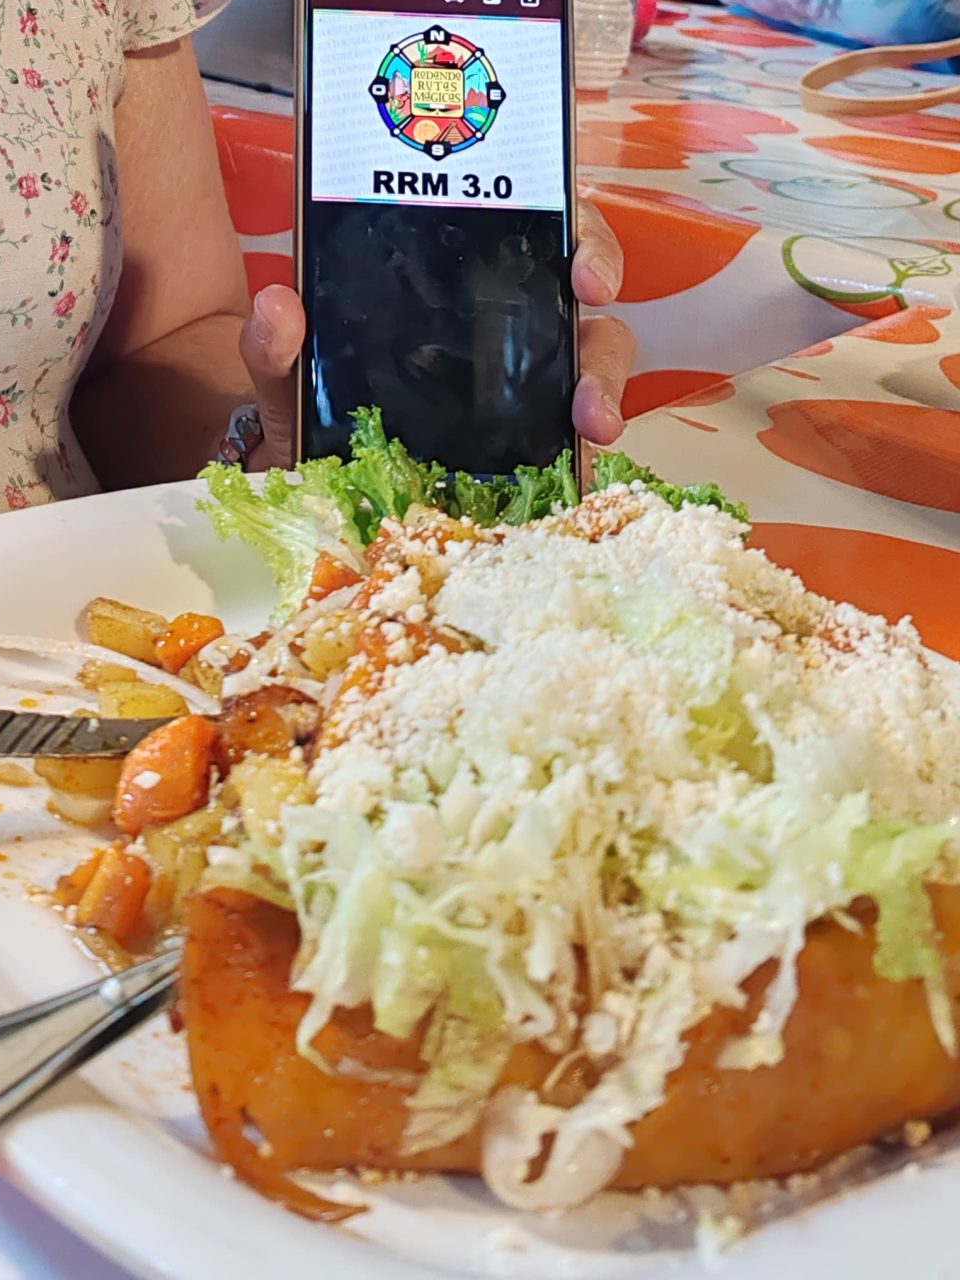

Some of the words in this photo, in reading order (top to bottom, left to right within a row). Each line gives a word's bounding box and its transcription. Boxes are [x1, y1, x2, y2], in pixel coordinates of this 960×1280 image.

[429, 30, 445, 41] N
[489, 89, 502, 100] E
[431, 144, 445, 156] S
[373, 170, 449, 197] RRM
[462, 173, 513, 200] 3.0
